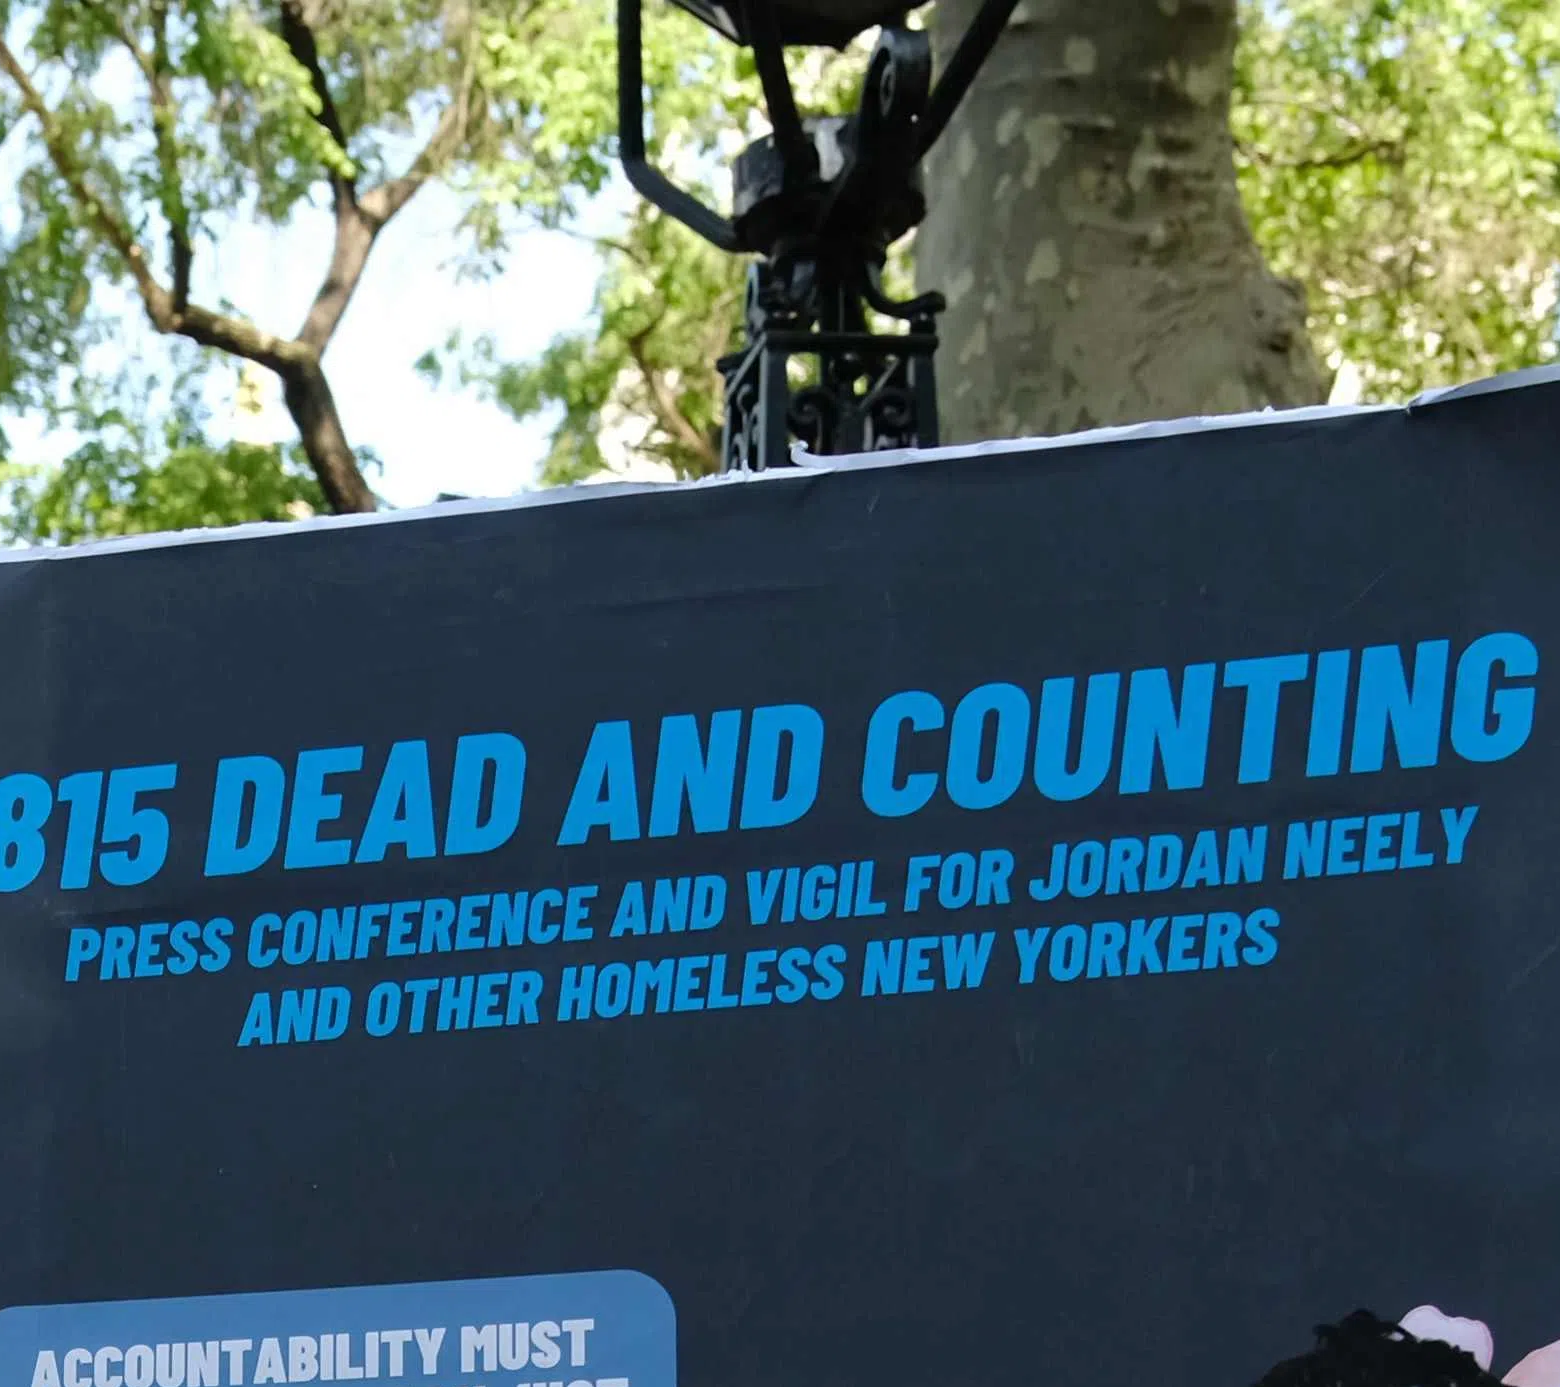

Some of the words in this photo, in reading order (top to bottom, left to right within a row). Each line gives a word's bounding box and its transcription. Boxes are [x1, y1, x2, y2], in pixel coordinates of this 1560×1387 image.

[203, 731, 528, 878] DEAD
[557, 702, 826, 847] AND
[861, 630, 1541, 818] COUNTING
[63, 915, 237, 983] PRESS
[247, 883, 600, 969] CONFERENCE
[609, 873, 729, 938] AND
[746, 858, 888, 926] VIGIL
[903, 847, 1017, 913] FOR
[1028, 823, 1270, 902] JORDAN
[1282, 803, 1480, 880] NEELY
[237, 984, 353, 1048] AND
[364, 968, 545, 1038] OTHER
[556, 943, 849, 1022] HOMELESS
[861, 928, 998, 997] NEW
[1014, 906, 1282, 985] YORKERS
[460, 1318, 595, 1373] MUST
